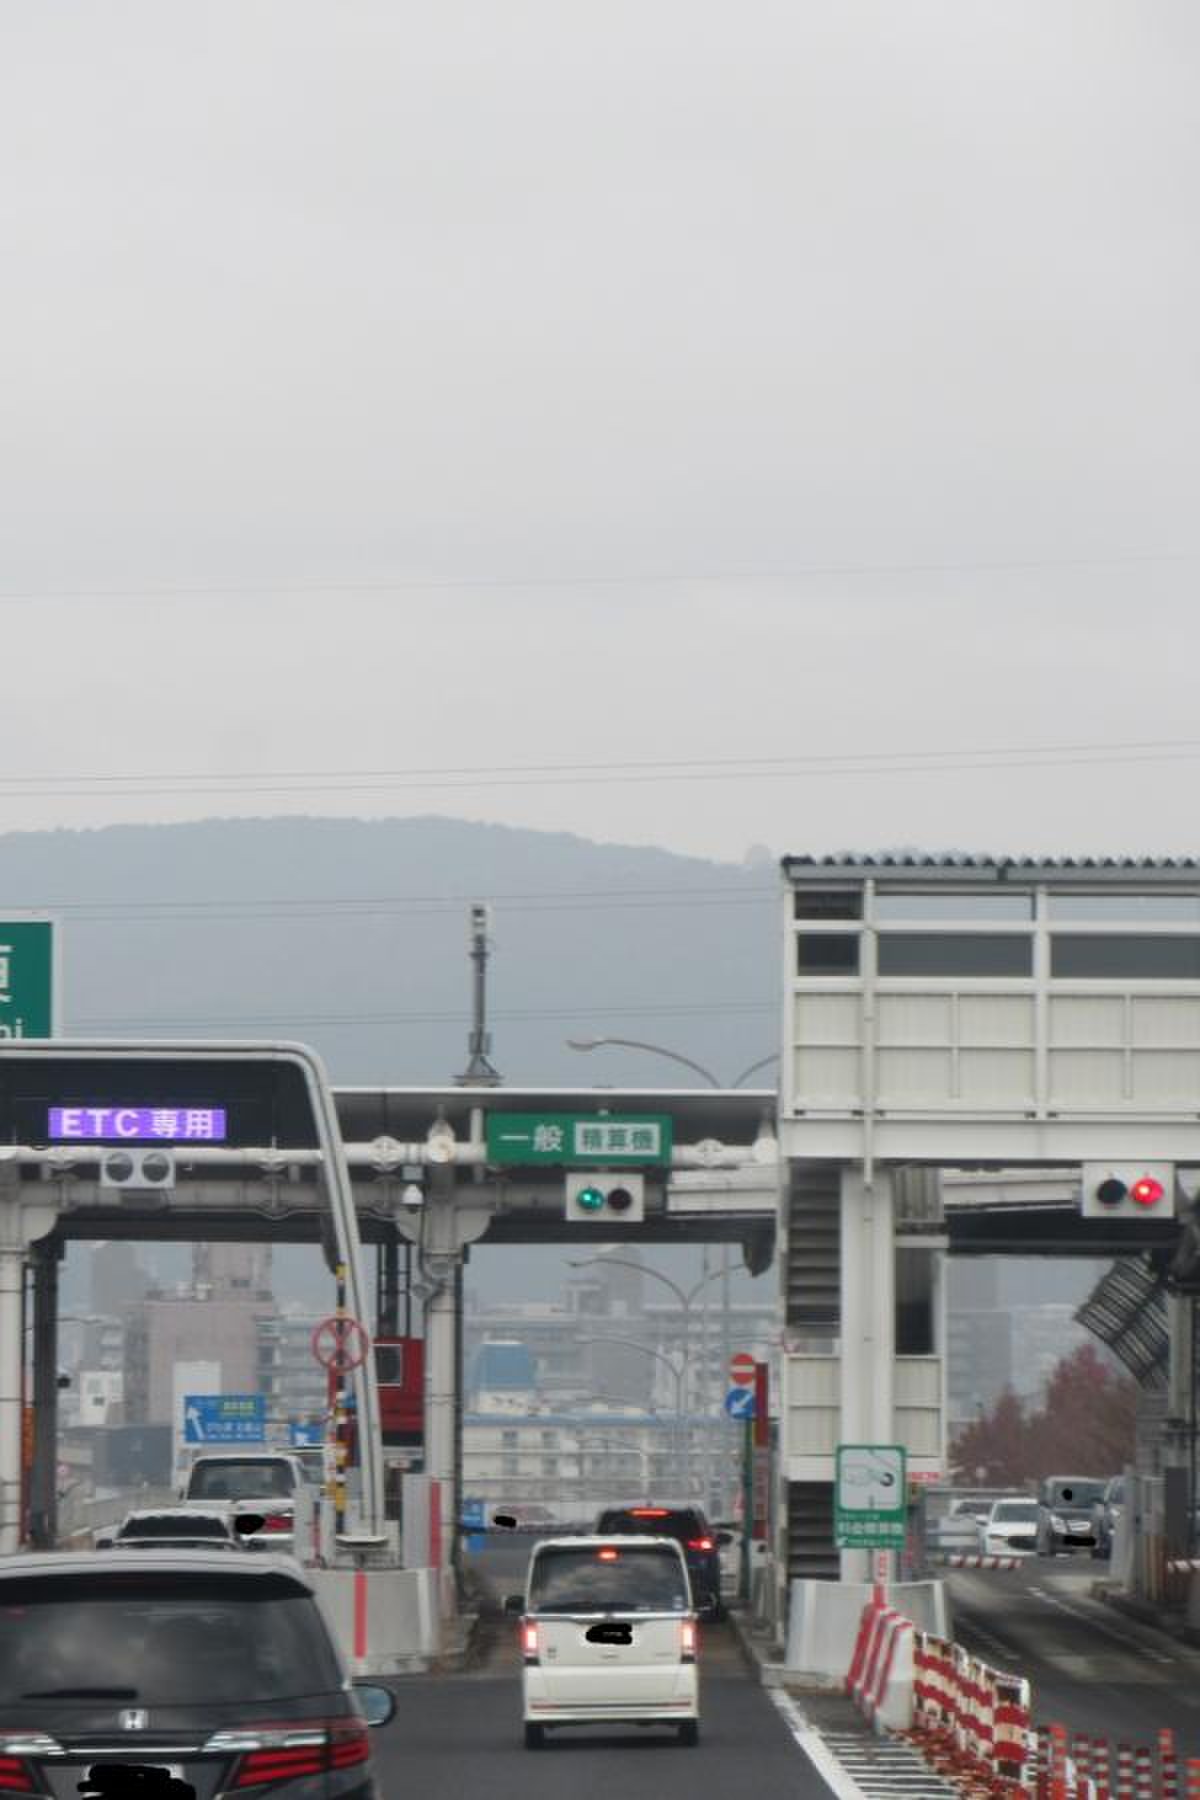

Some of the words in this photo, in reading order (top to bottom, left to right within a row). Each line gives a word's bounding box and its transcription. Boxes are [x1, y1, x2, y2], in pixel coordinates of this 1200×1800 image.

[61, 1109, 140, 1137] ETC
[151, 1109, 213, 1138] 専用
[500, 1123, 564, 1152] 一般
[581, 1126, 655, 1152] 精算機
